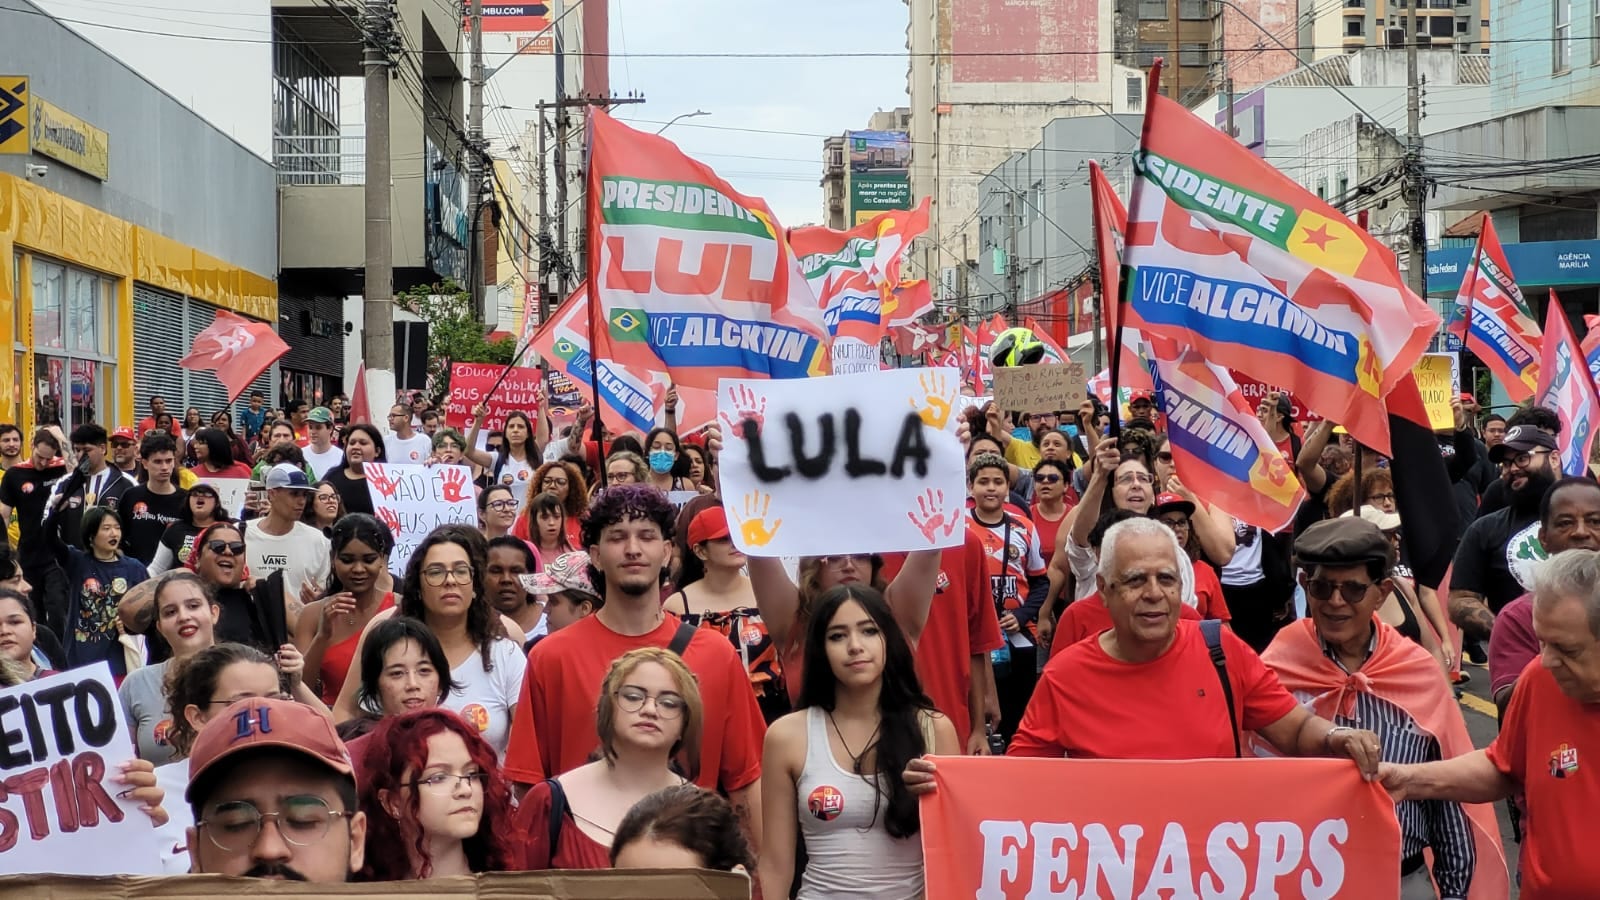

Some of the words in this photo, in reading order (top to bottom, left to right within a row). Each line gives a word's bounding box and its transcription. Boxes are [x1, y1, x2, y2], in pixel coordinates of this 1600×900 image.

[1557, 252, 1592, 261] AGÊNCIA
[1559, 260, 1590, 269] MARÍLIA
[1141, 271, 1191, 306] VICE
[1188, 280, 1348, 355] ALCKMIN
[453, 388, 480, 400] SUS
[504, 391, 537, 404] LULA
[741, 406, 933, 484] LULA
[262, 553, 288, 566] VANS
[975, 817, 1349, 900] FENASPS
